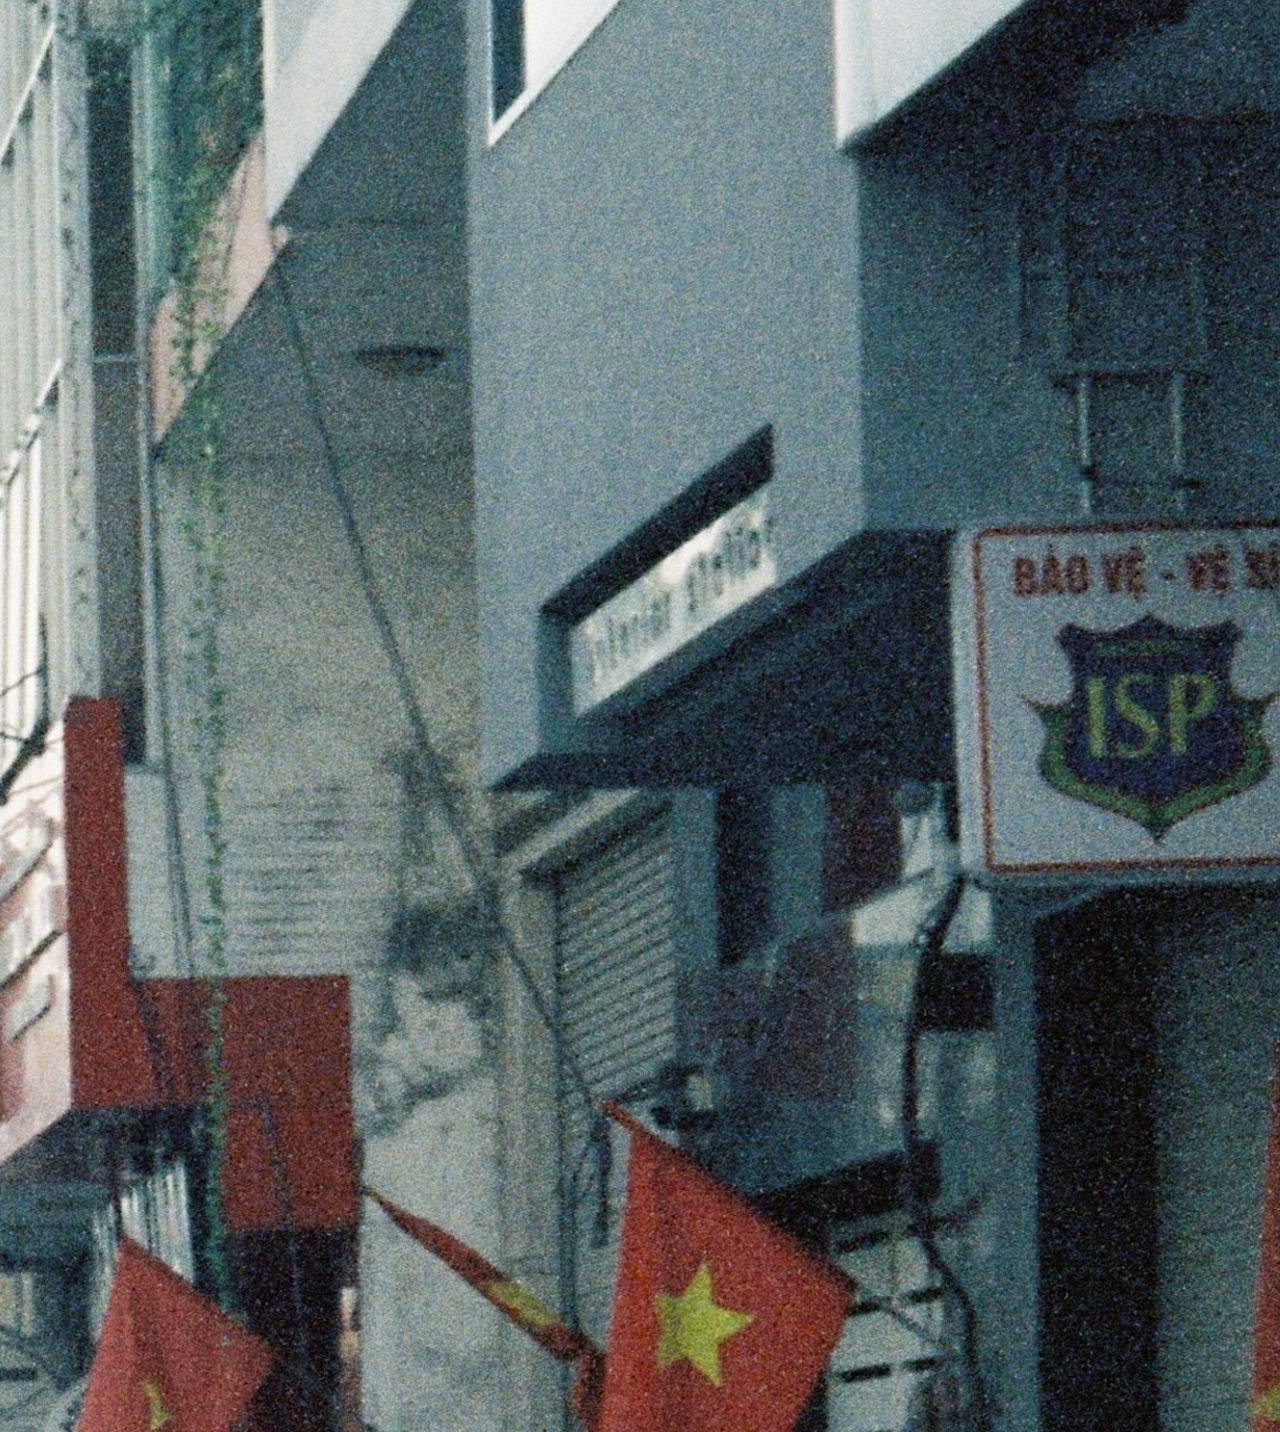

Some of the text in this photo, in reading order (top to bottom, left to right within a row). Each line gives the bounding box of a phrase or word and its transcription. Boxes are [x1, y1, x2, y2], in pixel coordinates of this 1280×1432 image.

[1014, 544, 1089, 597] BẢO
[1101, 543, 1146, 602] VỆ
[1185, 542, 1230, 599] VỆ
[1088, 670, 1216, 758] ISP
